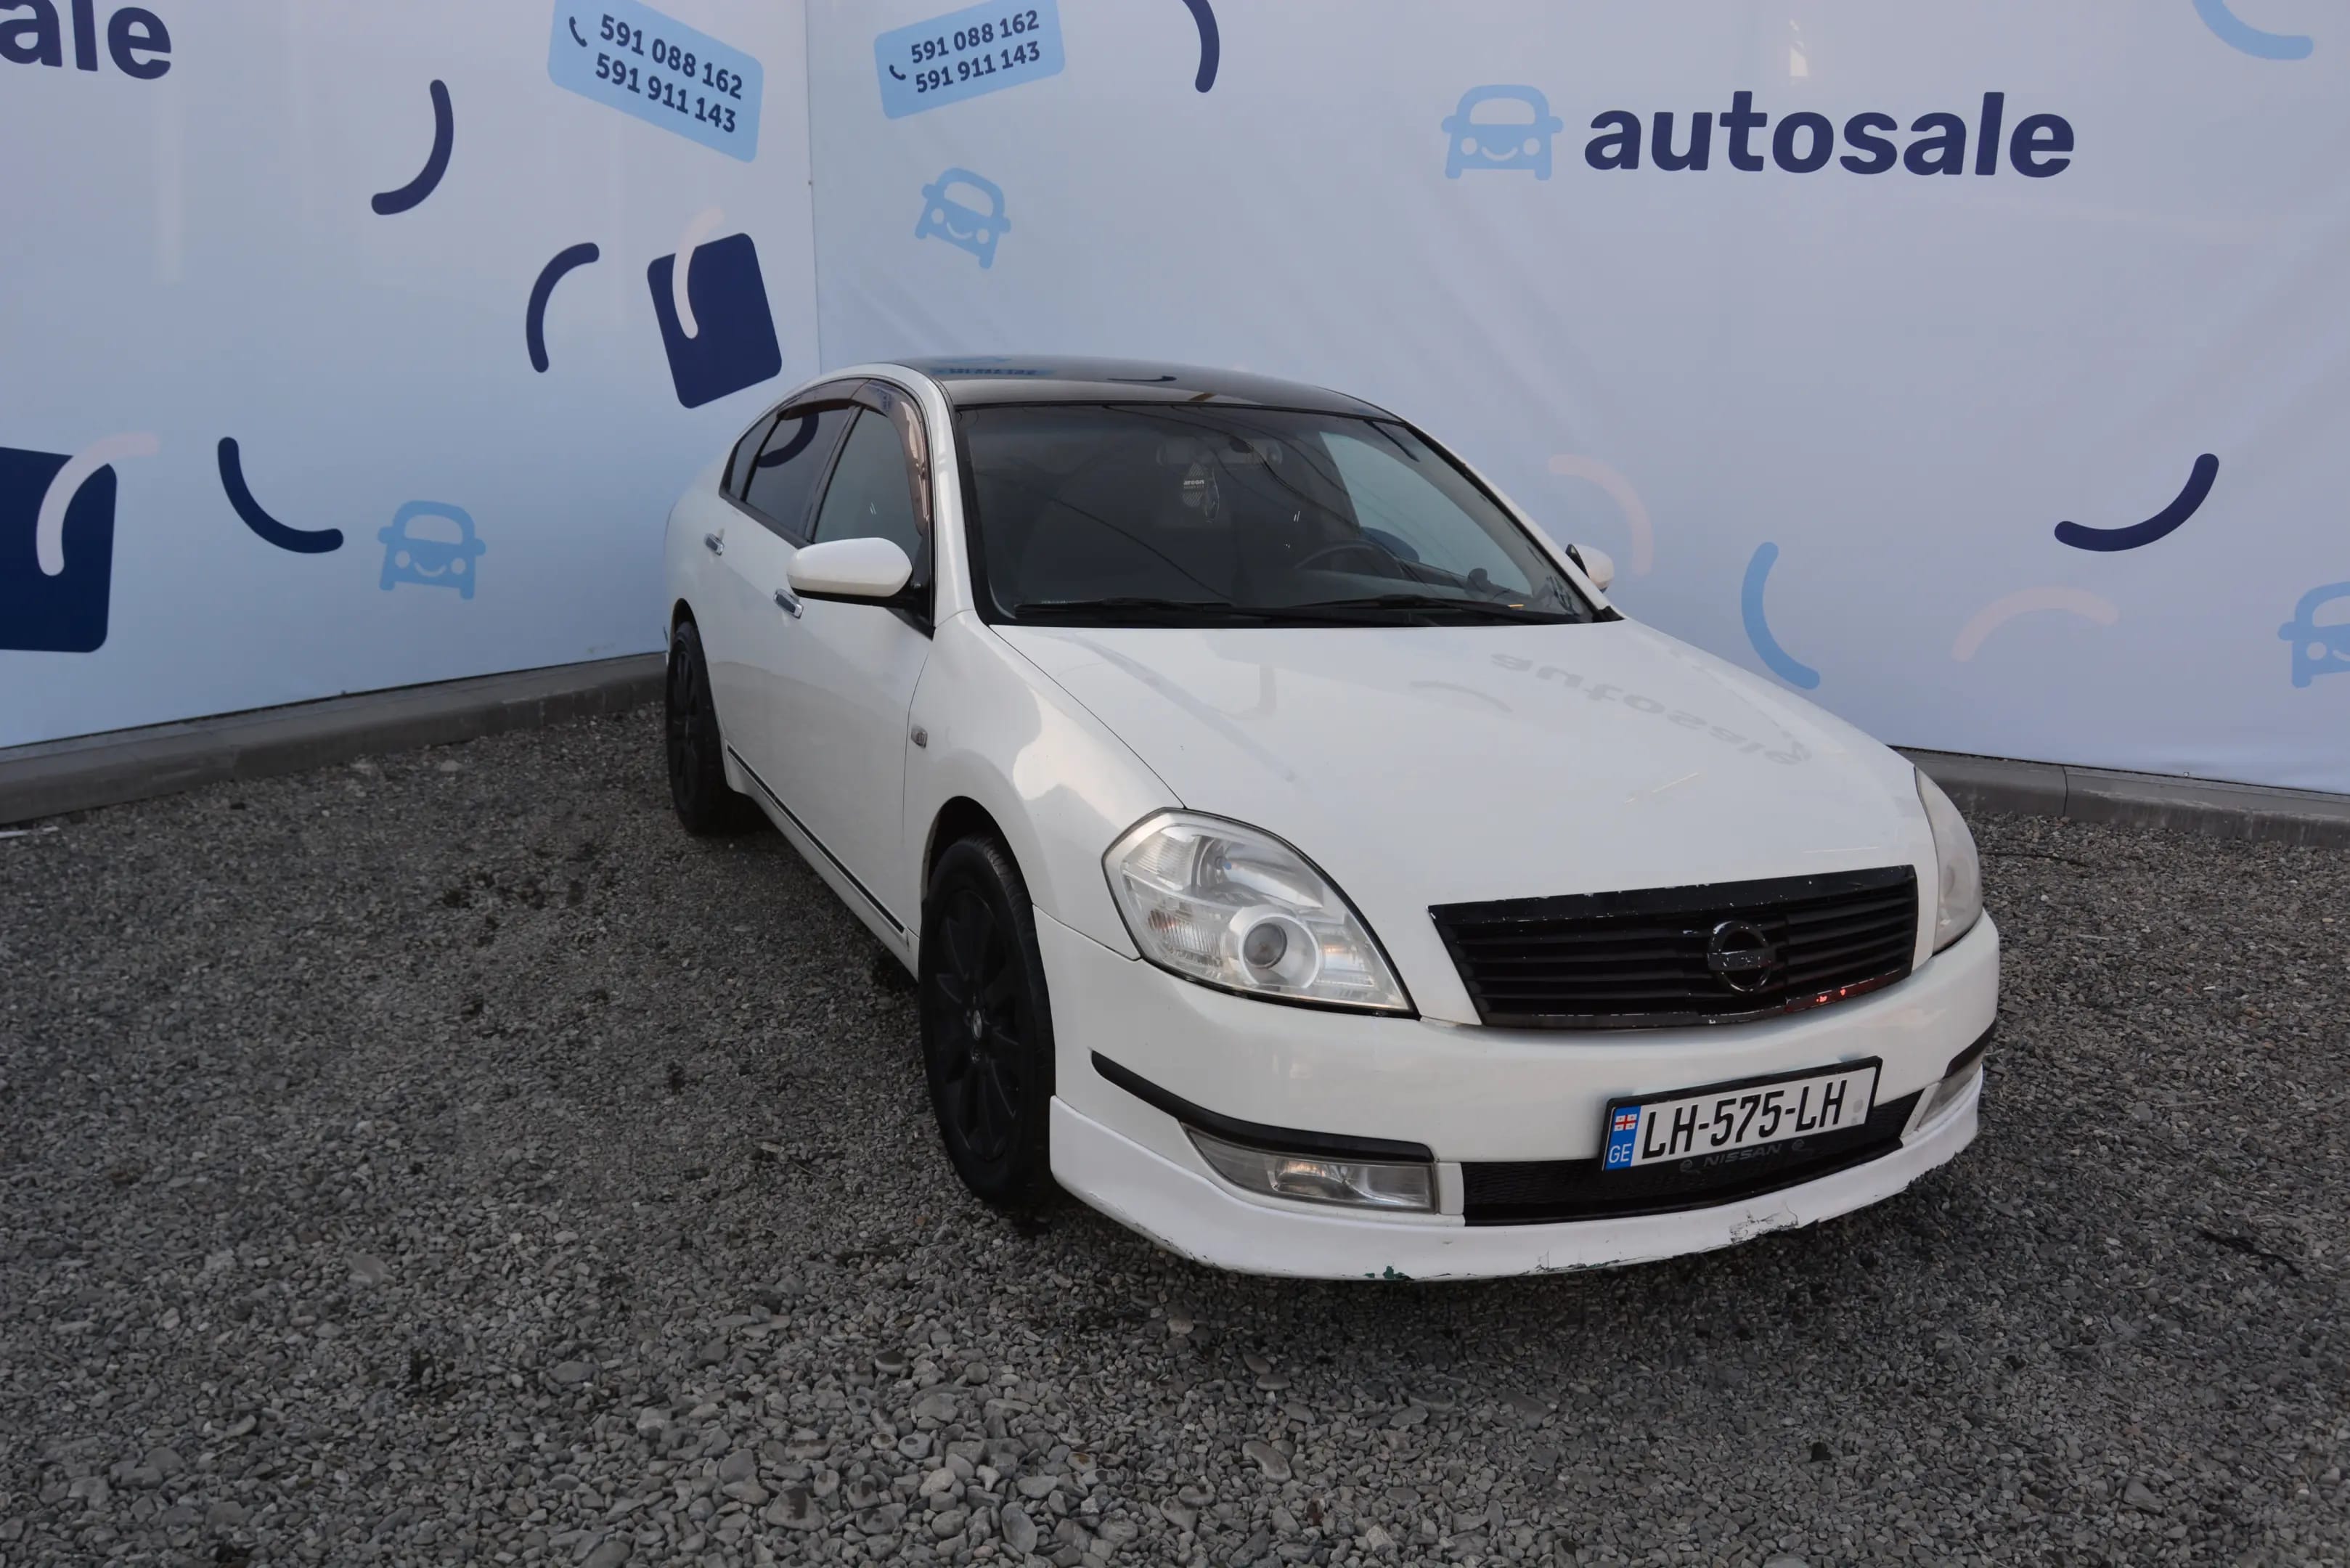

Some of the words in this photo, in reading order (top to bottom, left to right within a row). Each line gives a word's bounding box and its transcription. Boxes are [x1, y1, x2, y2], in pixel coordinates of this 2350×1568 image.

[0, 0, 171, 80] ale
[599, 13, 645, 57] 591
[651, 38, 697, 78] 088
[701, 61, 743, 101] 162
[910, 36, 950, 65] 591
[952, 23, 995, 52] 088
[999, 9, 1040, 39] 162
[915, 66, 955, 94] 591
[956, 53, 997, 82] 911
[1000, 40, 1041, 70] 143
[595, 52, 641, 94] 591
[647, 75, 690, 115] 911
[694, 96, 737, 134] 143
[1584, 91, 2076, 179] autosale
[1608, 1143, 1633, 1164] GE
[1641, 1079, 1848, 1159] LH-575-LH
